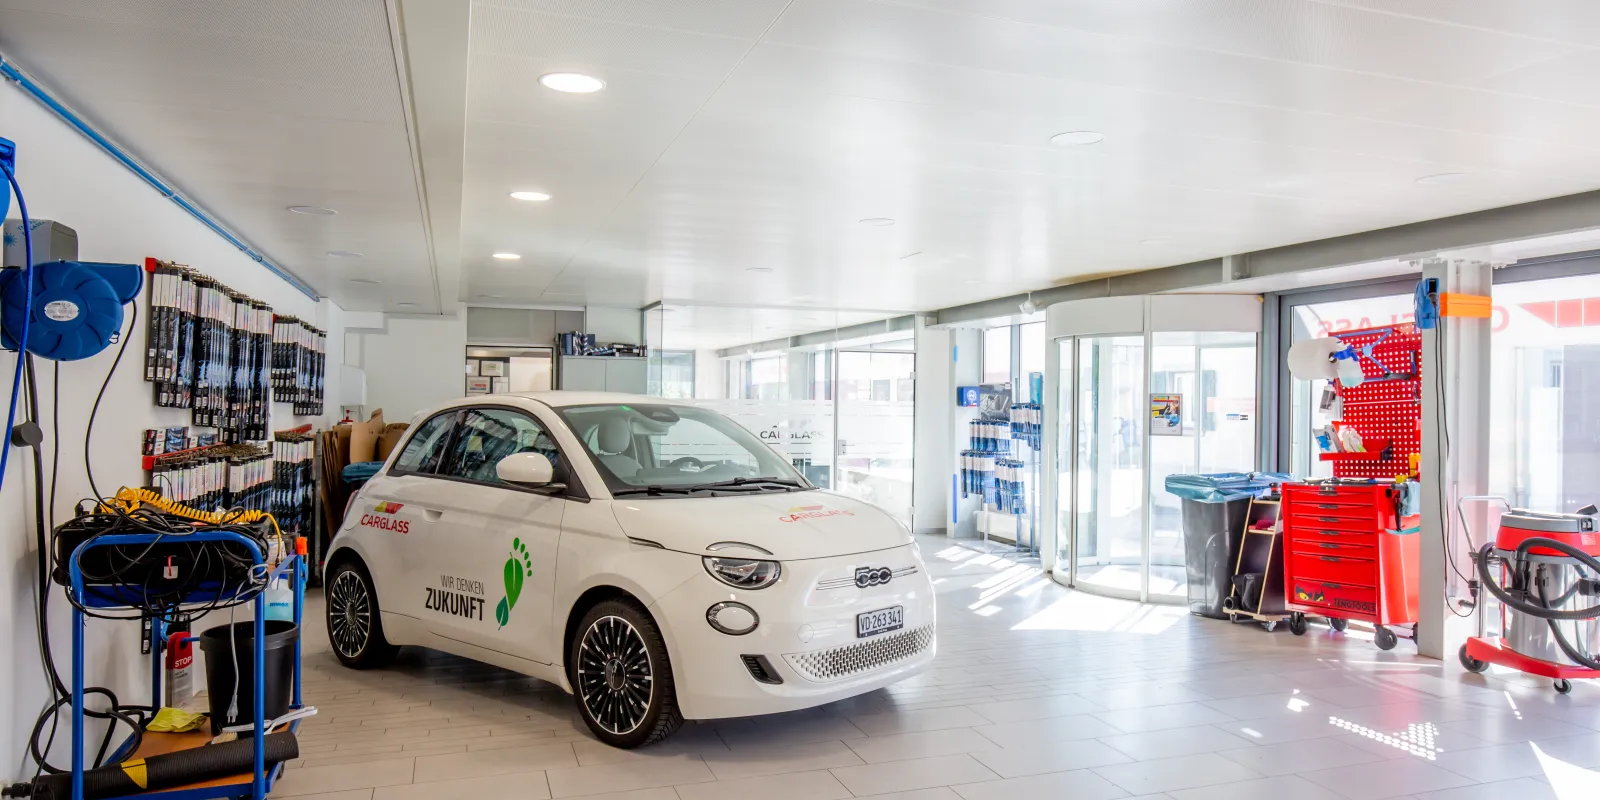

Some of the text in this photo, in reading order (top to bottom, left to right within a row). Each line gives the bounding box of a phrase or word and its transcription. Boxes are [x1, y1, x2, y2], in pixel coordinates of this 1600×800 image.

[361, 514, 410, 534] CARGLASS
[778, 509, 855, 523] CARGLASS
[441, 575, 484, 595] WIR DENKEN
[425, 587, 485, 621] ZUKUNFT
[174, 656, 192, 668] STOP
